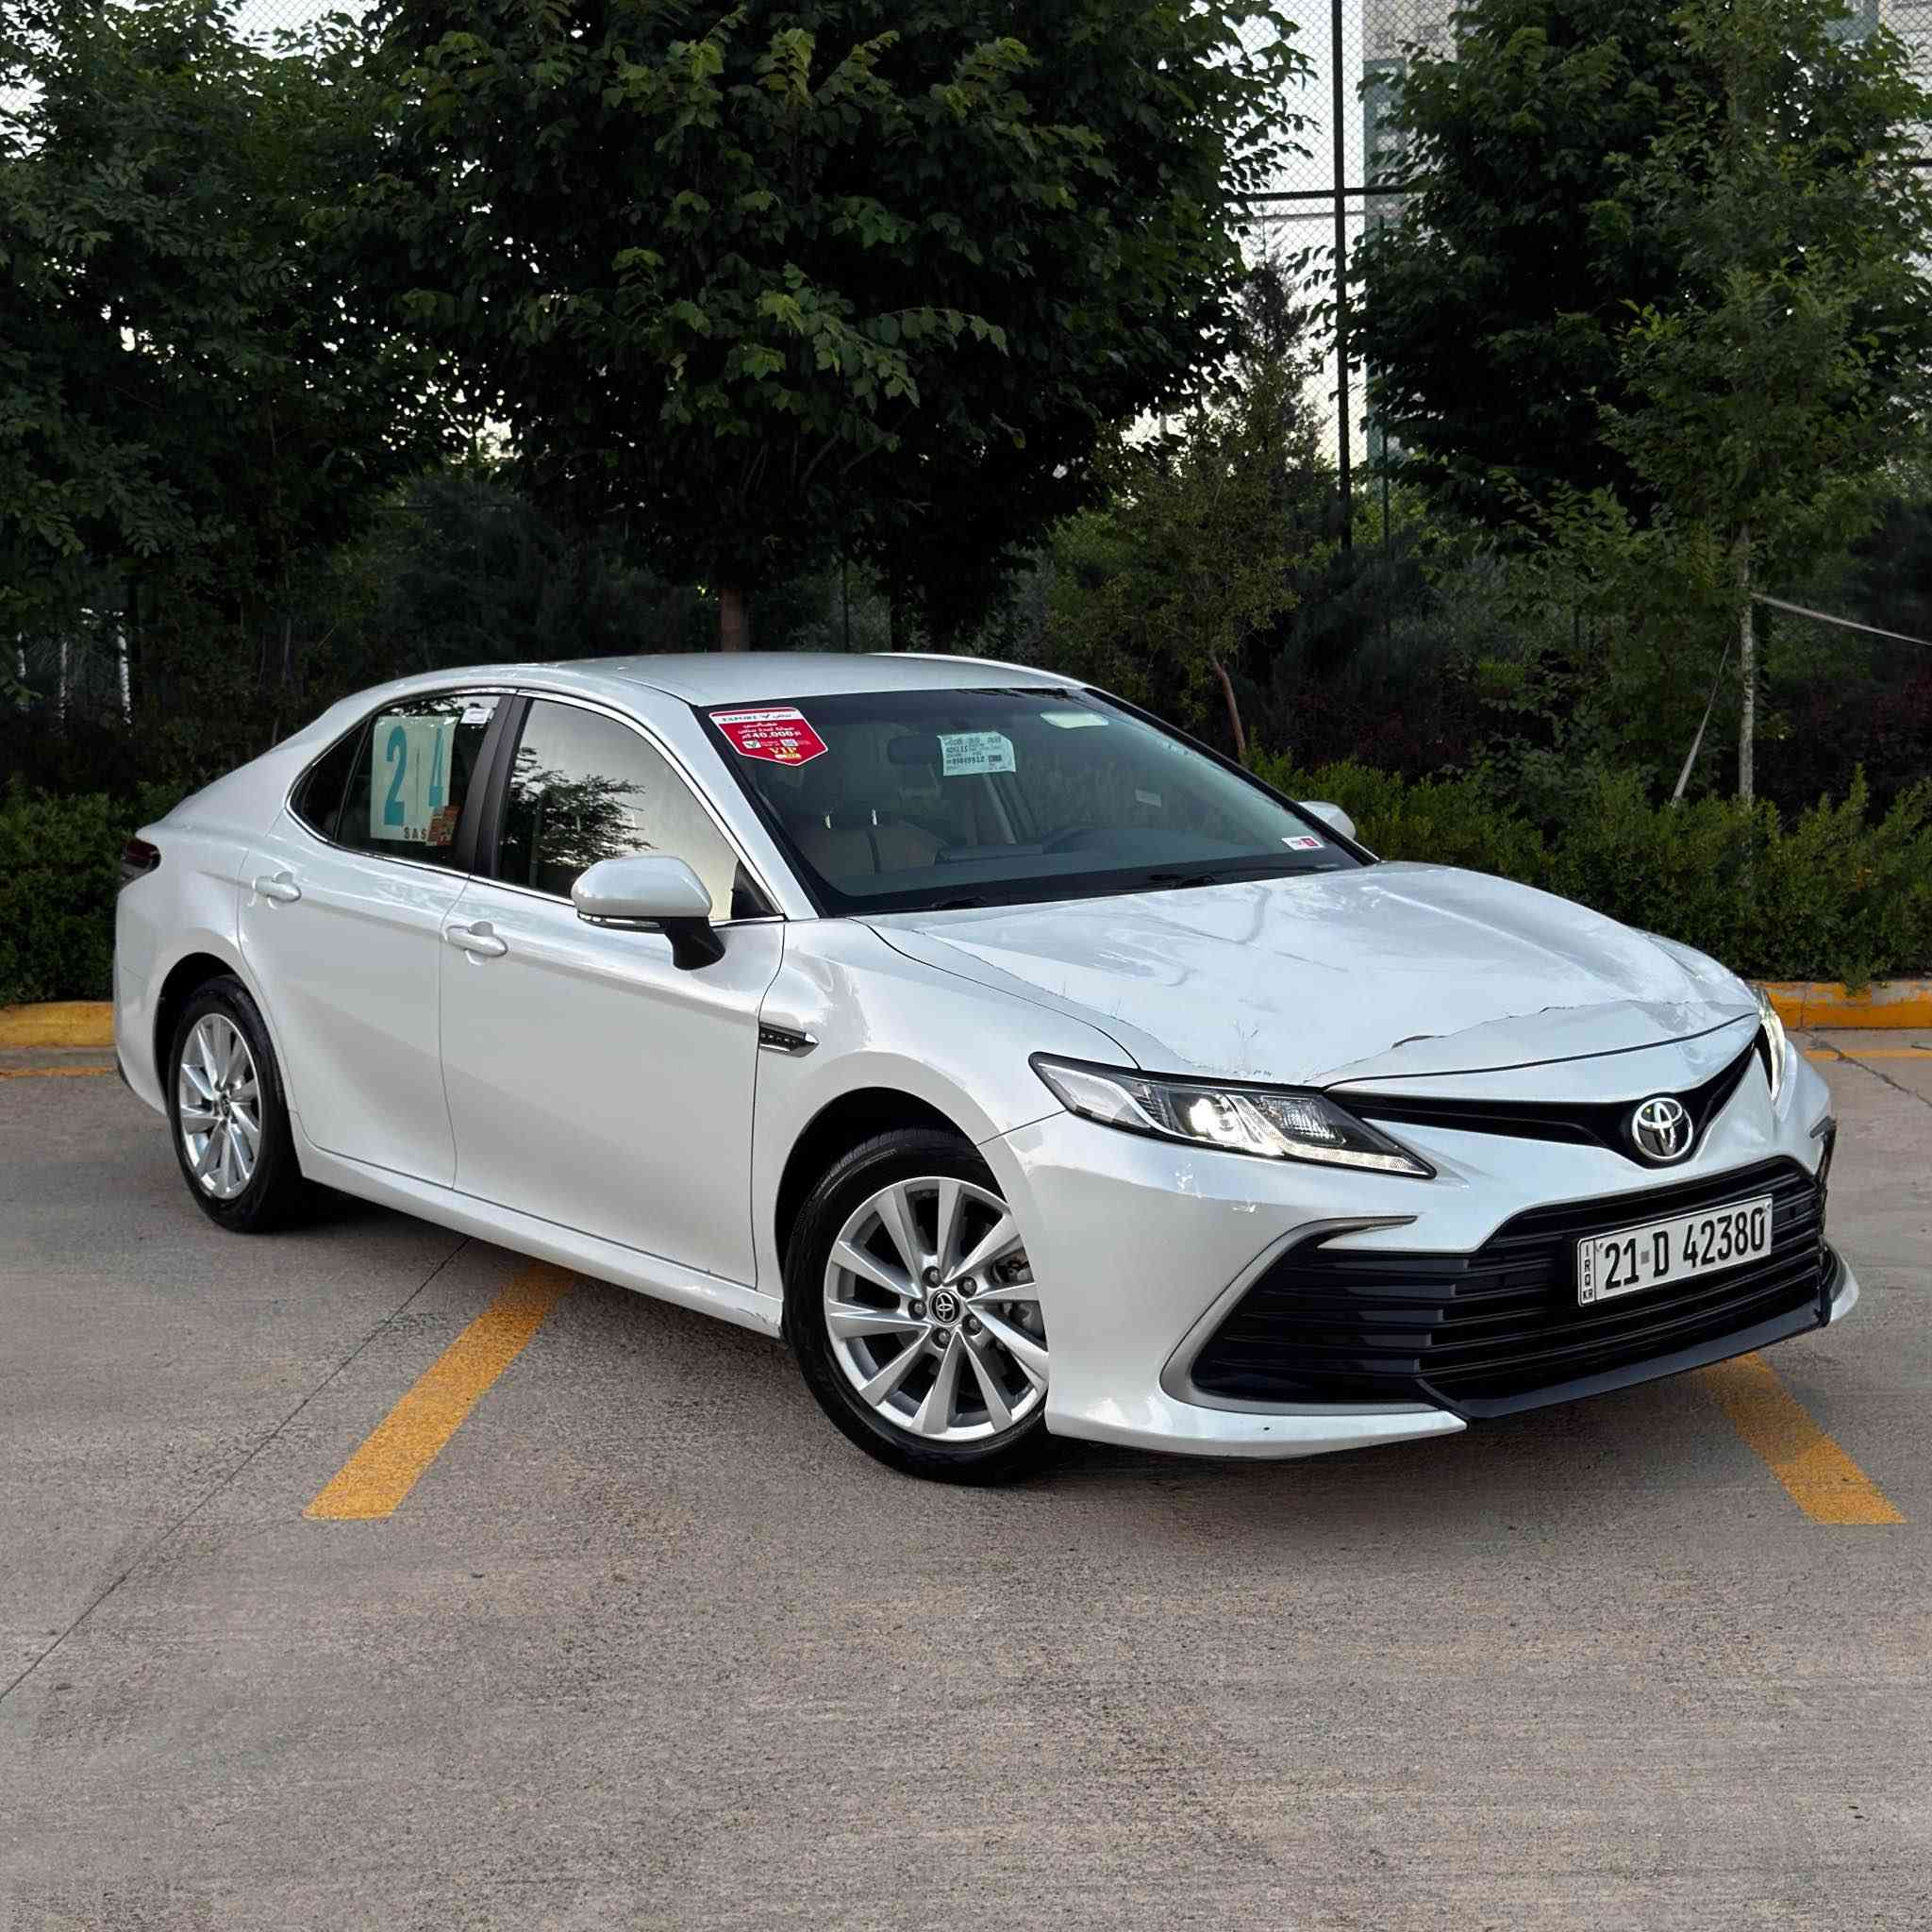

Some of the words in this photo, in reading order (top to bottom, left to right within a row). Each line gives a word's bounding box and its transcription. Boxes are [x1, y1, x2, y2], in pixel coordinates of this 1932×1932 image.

[1606, 1238, 1640, 1290] 21
[1653, 1230, 1670, 1277] D
[1683, 1207, 1766, 1269] 42380
[1582, 1289, 1593, 1300] KR
